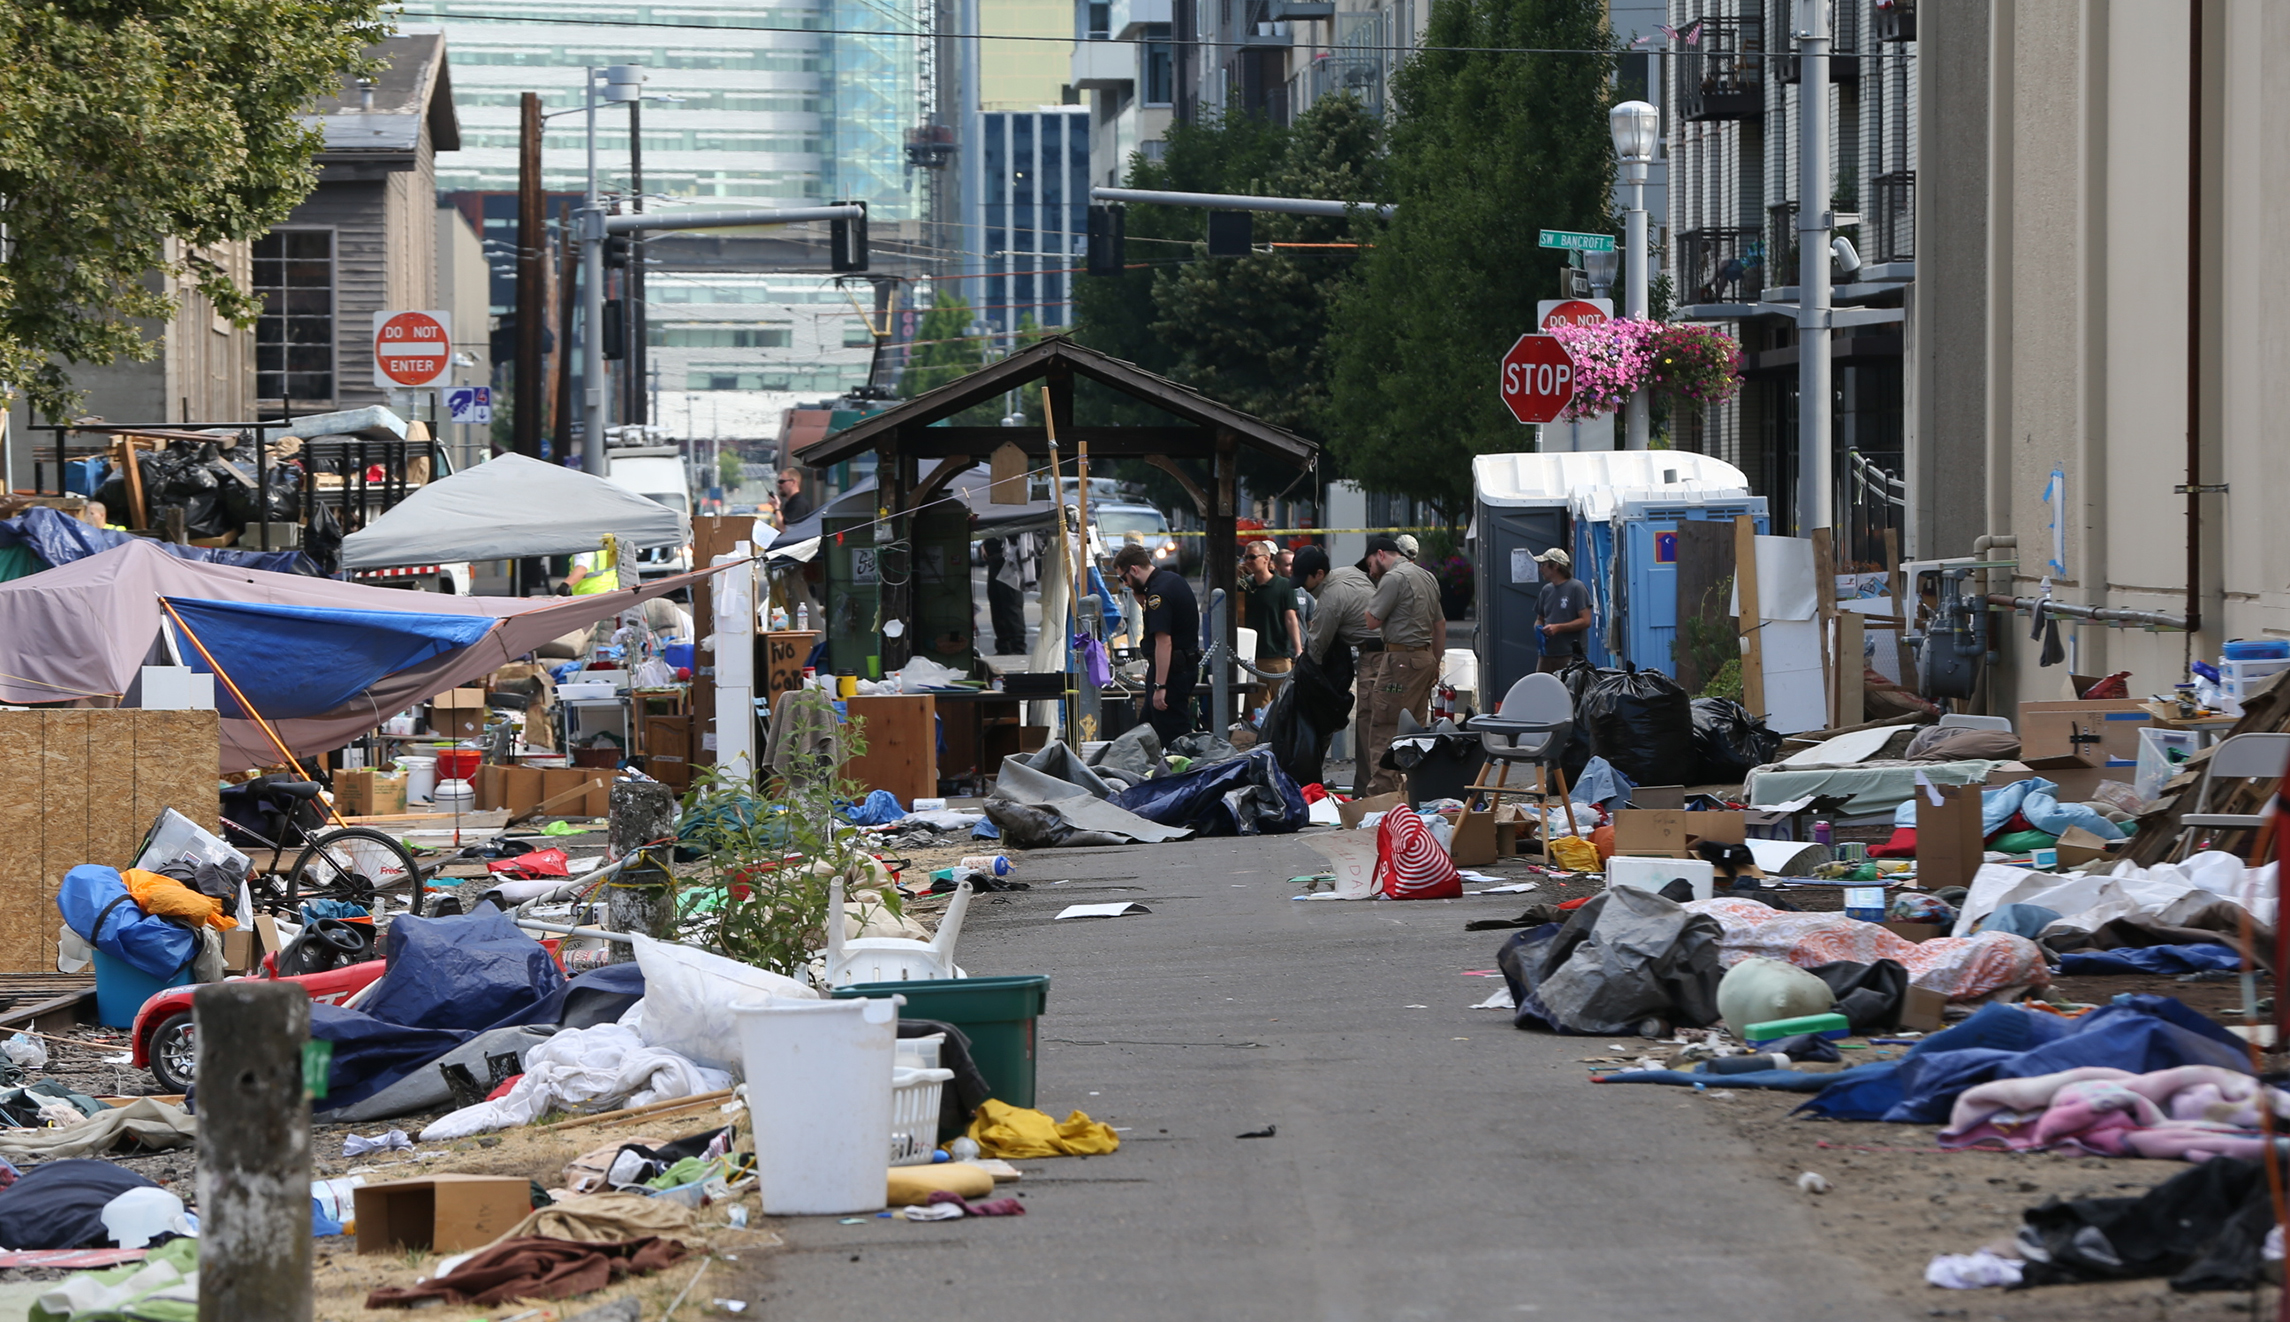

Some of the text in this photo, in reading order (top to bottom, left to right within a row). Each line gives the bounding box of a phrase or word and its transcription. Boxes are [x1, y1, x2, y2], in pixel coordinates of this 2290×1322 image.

[1540, 233, 1554, 245] SW
[1560, 235, 1605, 249] BANCROFT
[1549, 314, 1601, 327] DO NOT
[385, 326, 439, 338] DO NOT
[390, 360, 435, 372] ENTER
[1505, 362, 1571, 396] STOP
